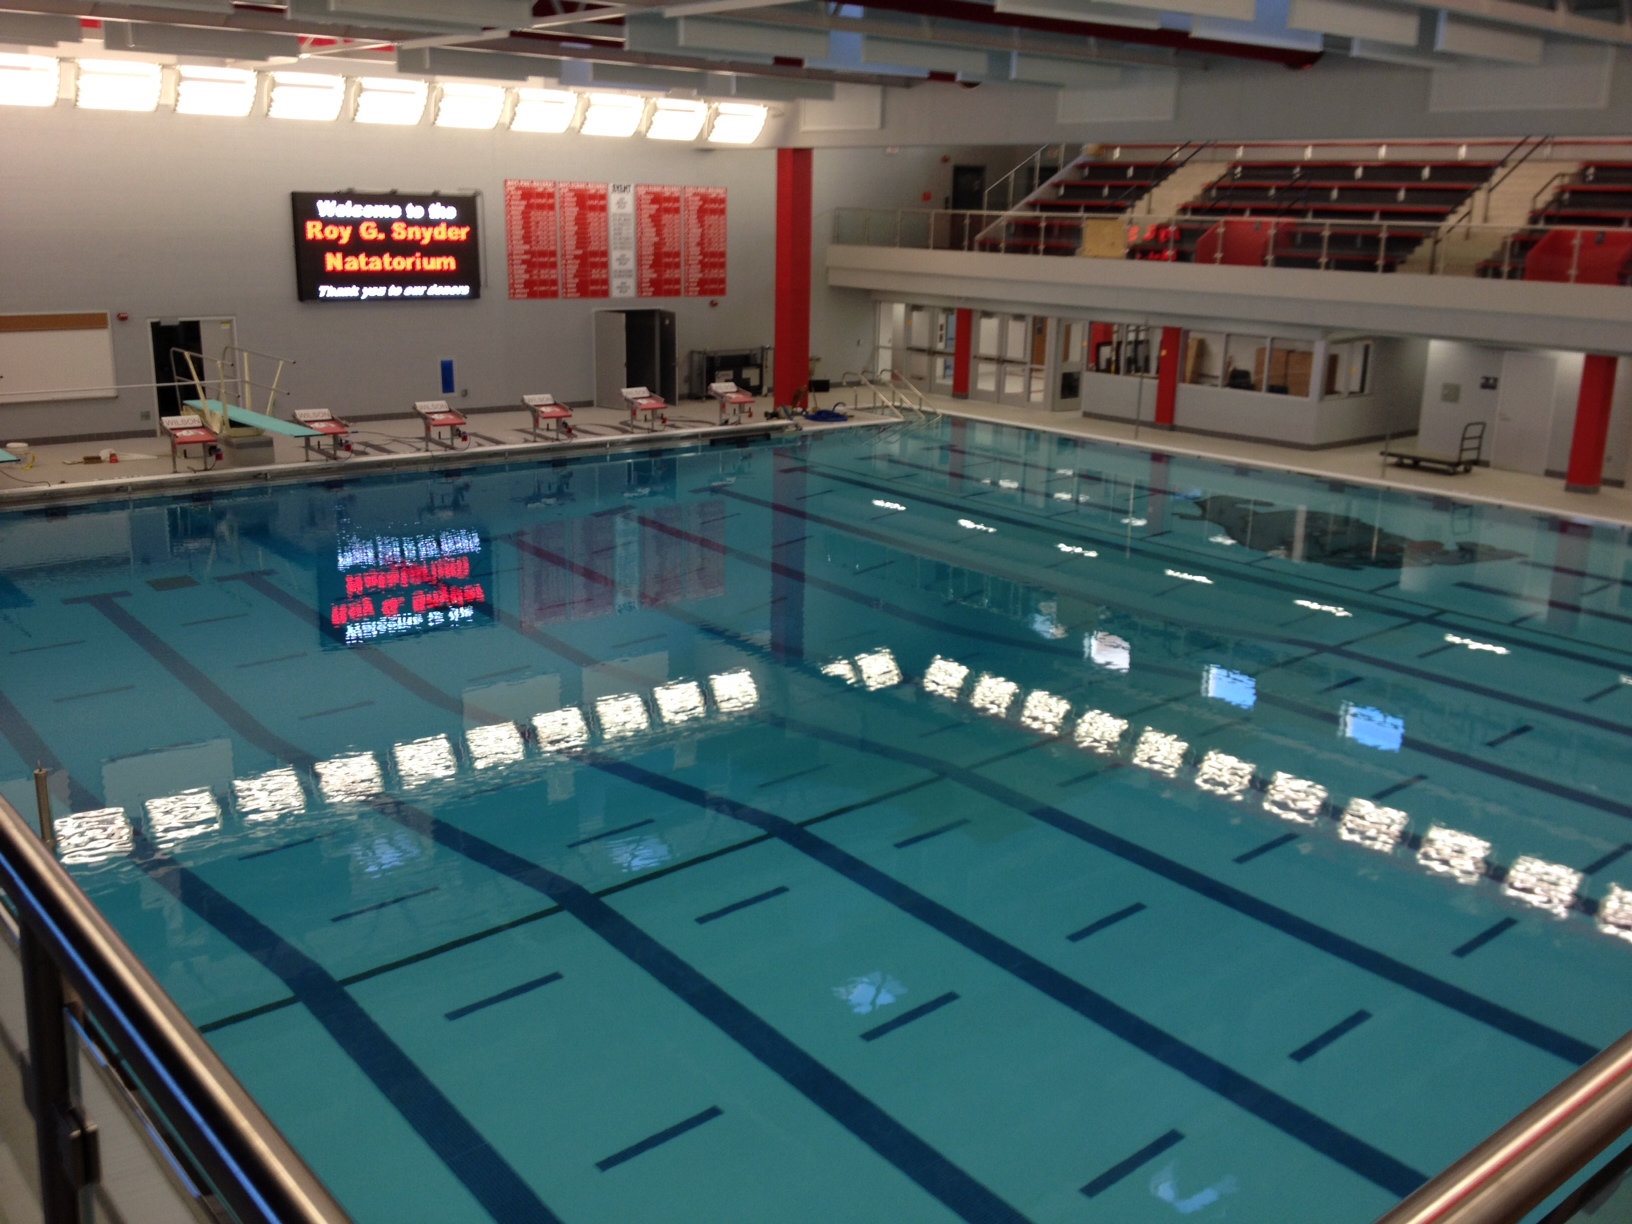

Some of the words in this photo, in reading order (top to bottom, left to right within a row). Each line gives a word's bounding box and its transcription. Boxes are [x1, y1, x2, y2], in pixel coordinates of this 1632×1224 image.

[316, 200, 402, 218] Welcome
[405, 202, 425, 219] to
[428, 202, 457, 220] the
[305, 220, 352, 246] Roy
[359, 220, 386, 241] G.
[390, 221, 471, 246] Snyder
[324, 251, 457, 272] Natatorium
[318, 285, 359, 298] Thank
[361, 285, 386, 299] you
[418, 402, 448, 410] WILSON
[299, 410, 330, 419] WILSON
[165, 418, 201, 427] WILSON
